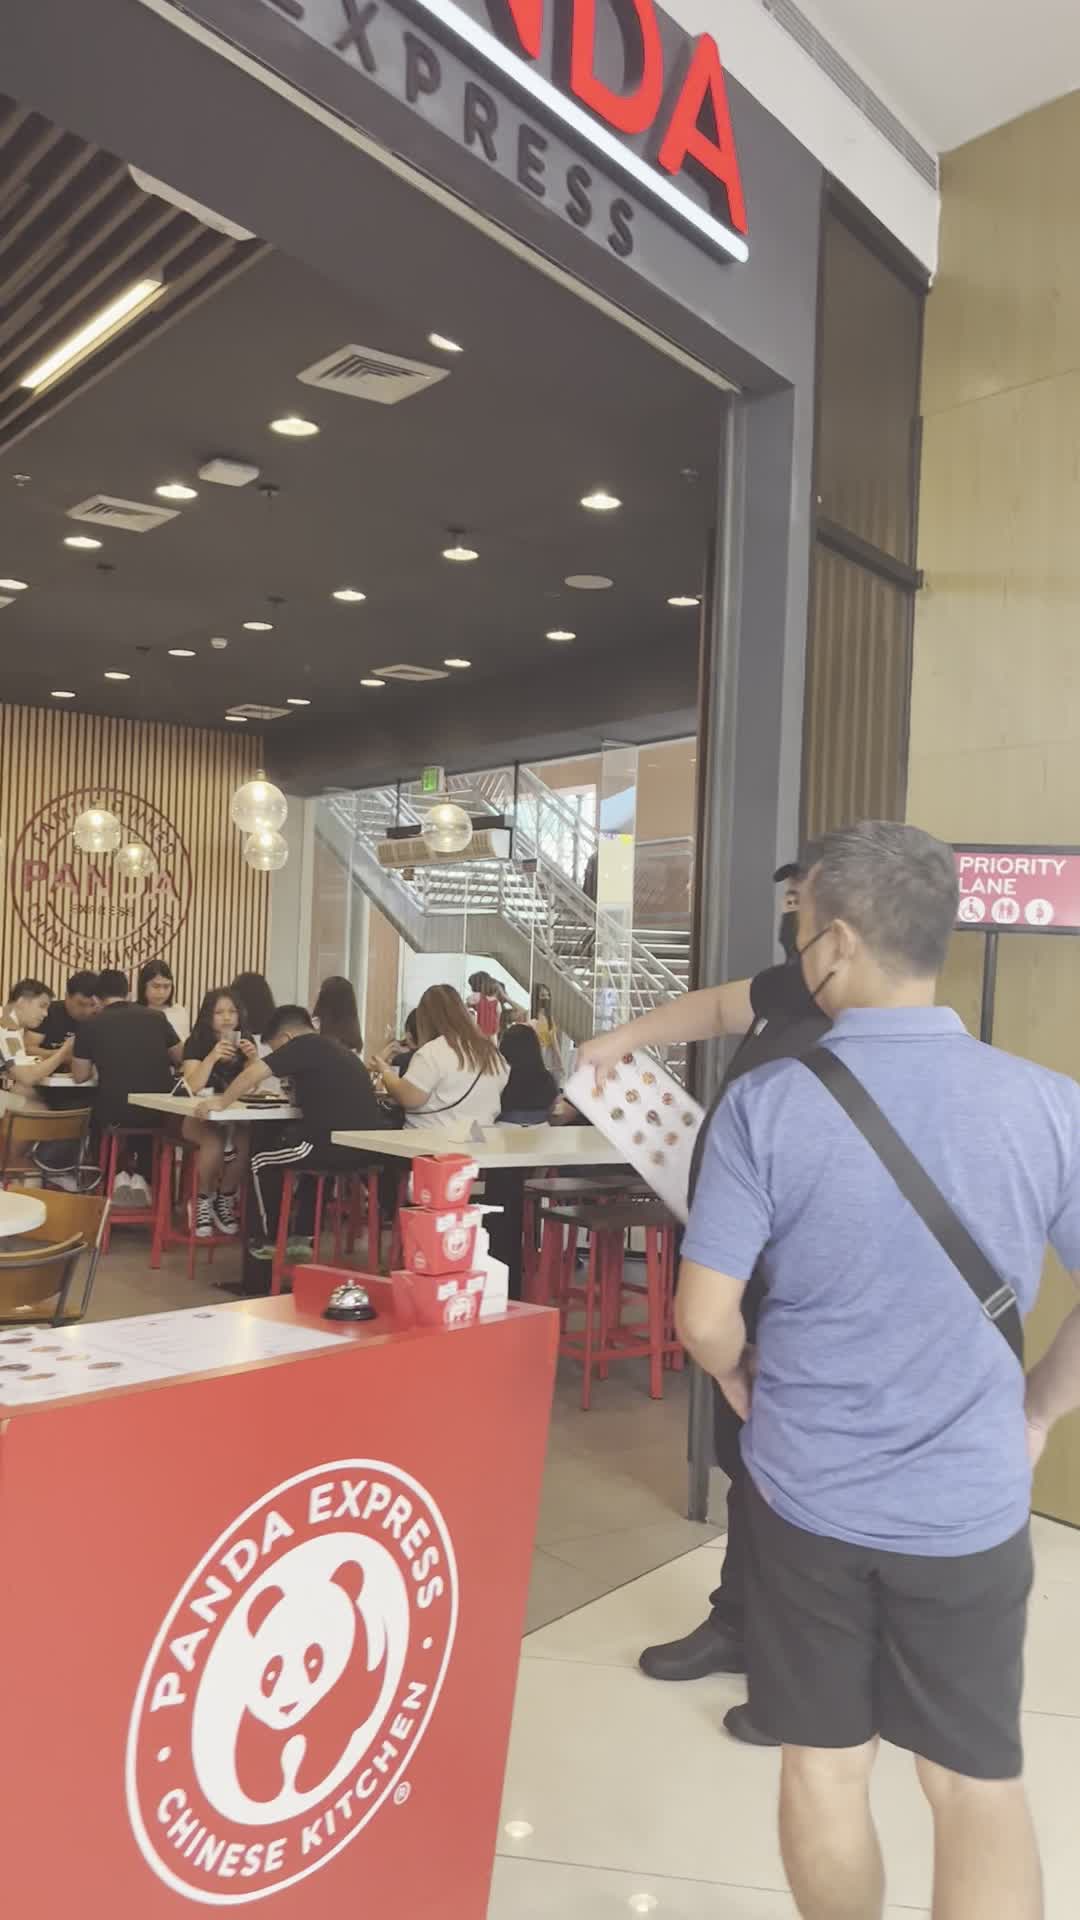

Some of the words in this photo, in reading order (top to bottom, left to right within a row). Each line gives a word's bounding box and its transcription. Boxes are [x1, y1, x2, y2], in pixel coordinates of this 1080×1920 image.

[262, 0, 634, 258] XPRESS
[958, 876, 1017, 895] LANE
[959, 856, 1068, 876] PRIORITY
[150, 1510, 295, 1713] PANDA
[308, 1479, 444, 1610] EXPRESS
[157, 1787, 289, 1878] CHINESE
[301, 1680, 429, 1856] KITCHEN
